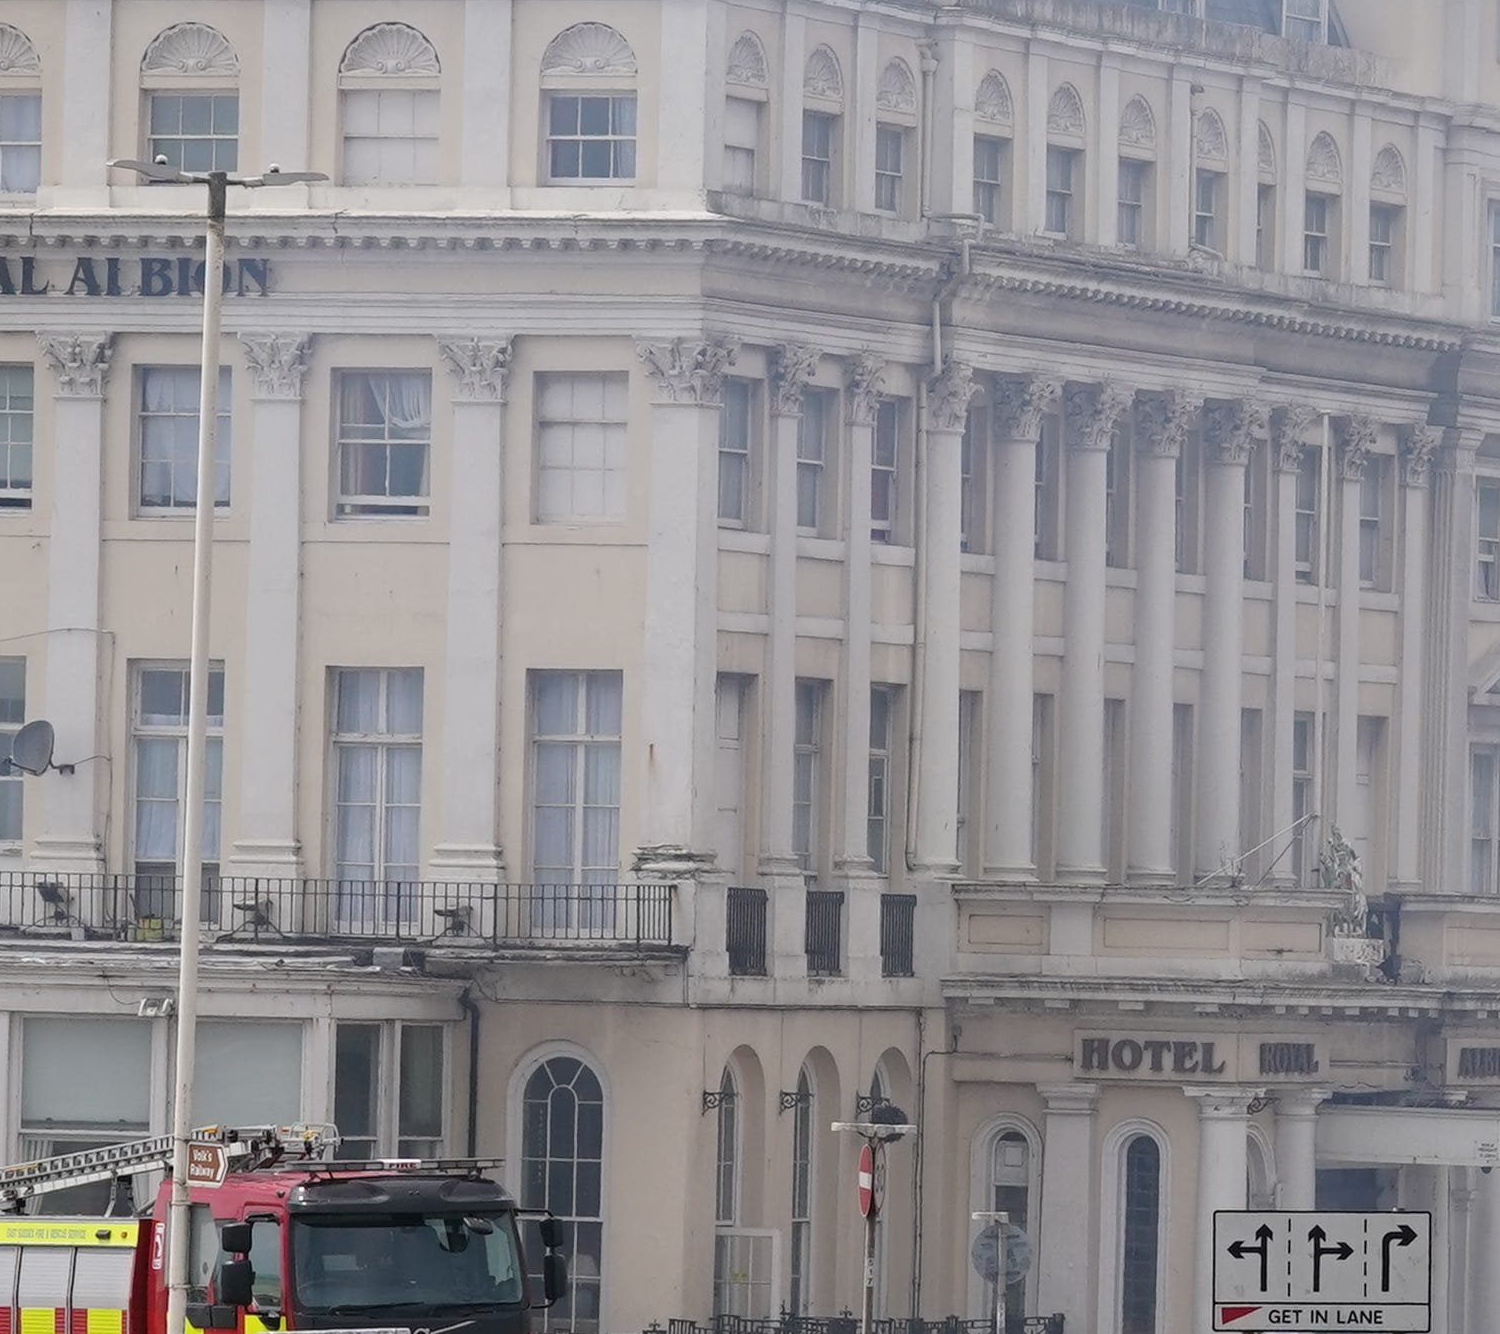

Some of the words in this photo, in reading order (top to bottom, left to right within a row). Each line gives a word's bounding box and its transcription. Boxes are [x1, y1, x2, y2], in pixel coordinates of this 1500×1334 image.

[1080, 1038, 1226, 1074] HOTEL
[1268, 1309, 1303, 1325] GET
[1310, 1310, 1329, 1325] IN
[1336, 1310, 1384, 1325] LANE
